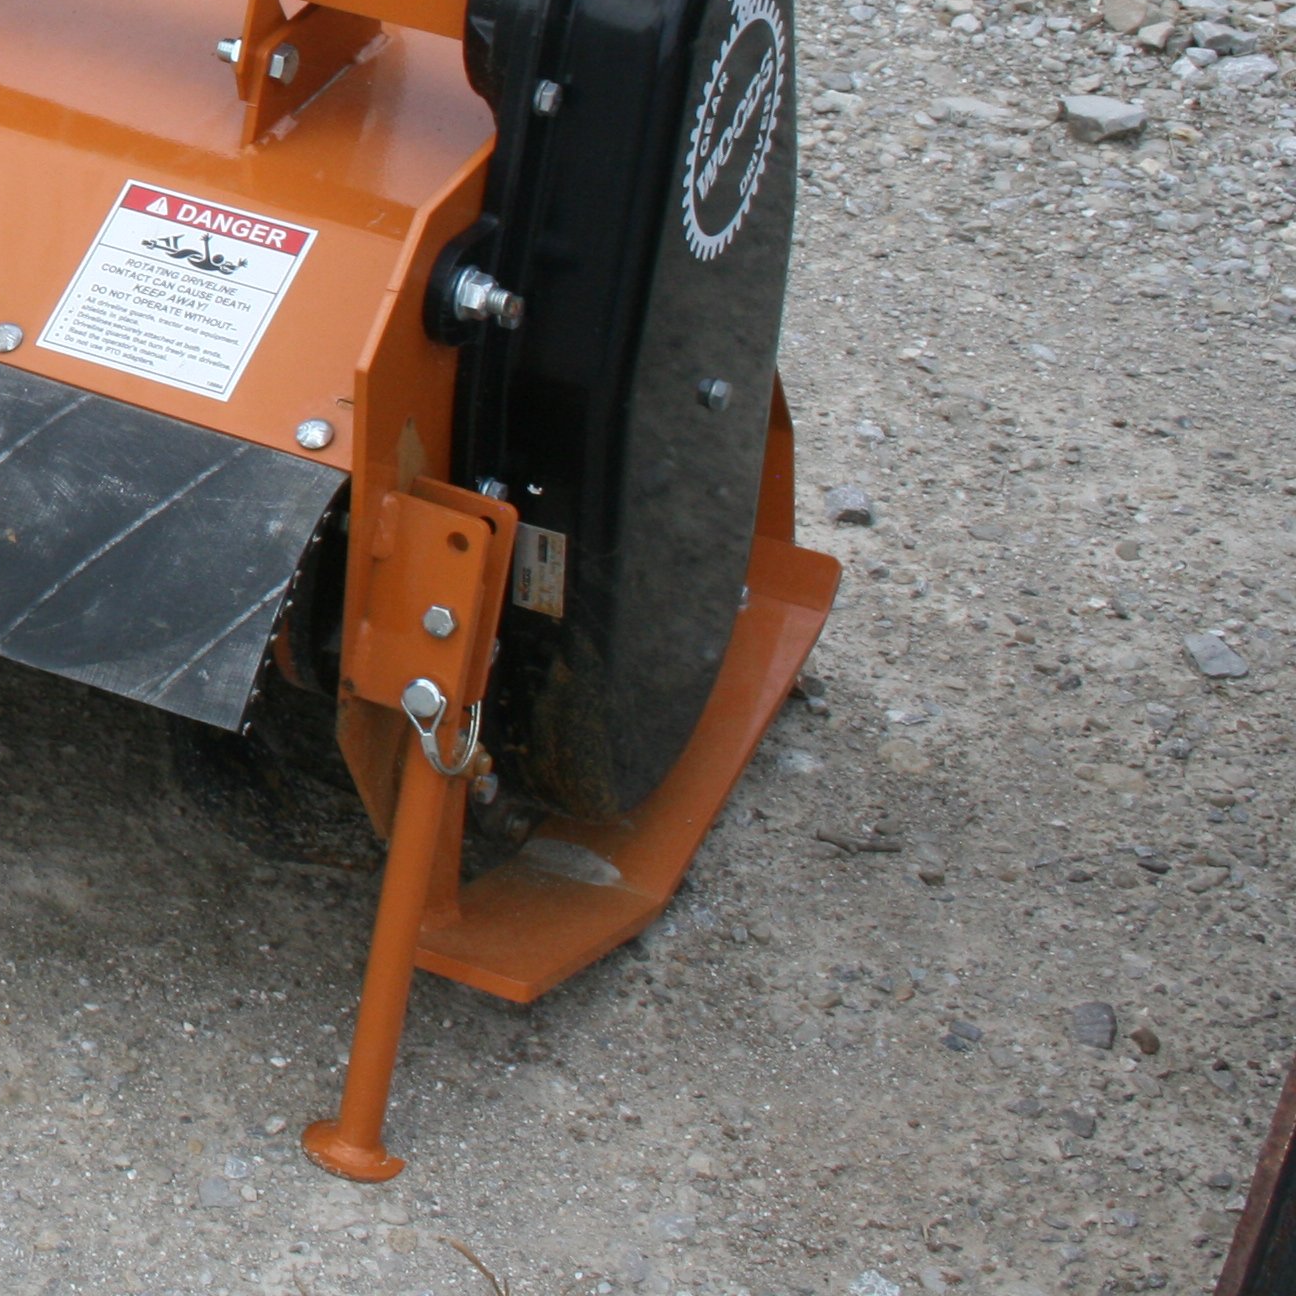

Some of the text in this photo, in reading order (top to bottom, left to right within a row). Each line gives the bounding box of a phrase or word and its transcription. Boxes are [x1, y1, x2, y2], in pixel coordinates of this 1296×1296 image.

[696, 47, 775, 202] WOODS
[699, 70, 730, 158] GEAR
[739, 91, 772, 197] DRIVEN
[175, 203, 289, 248] DANGER
[90, 284, 107, 294] DO
[108, 289, 131, 301] NOT
[131, 296, 183, 316] OPERATE
[100, 263, 252, 311] CONTACT CAN CAUSE DEATH
[124, 258, 238, 296] ROTATING DRIVELINE
[132, 283, 209, 311] KEEP AWAY!
